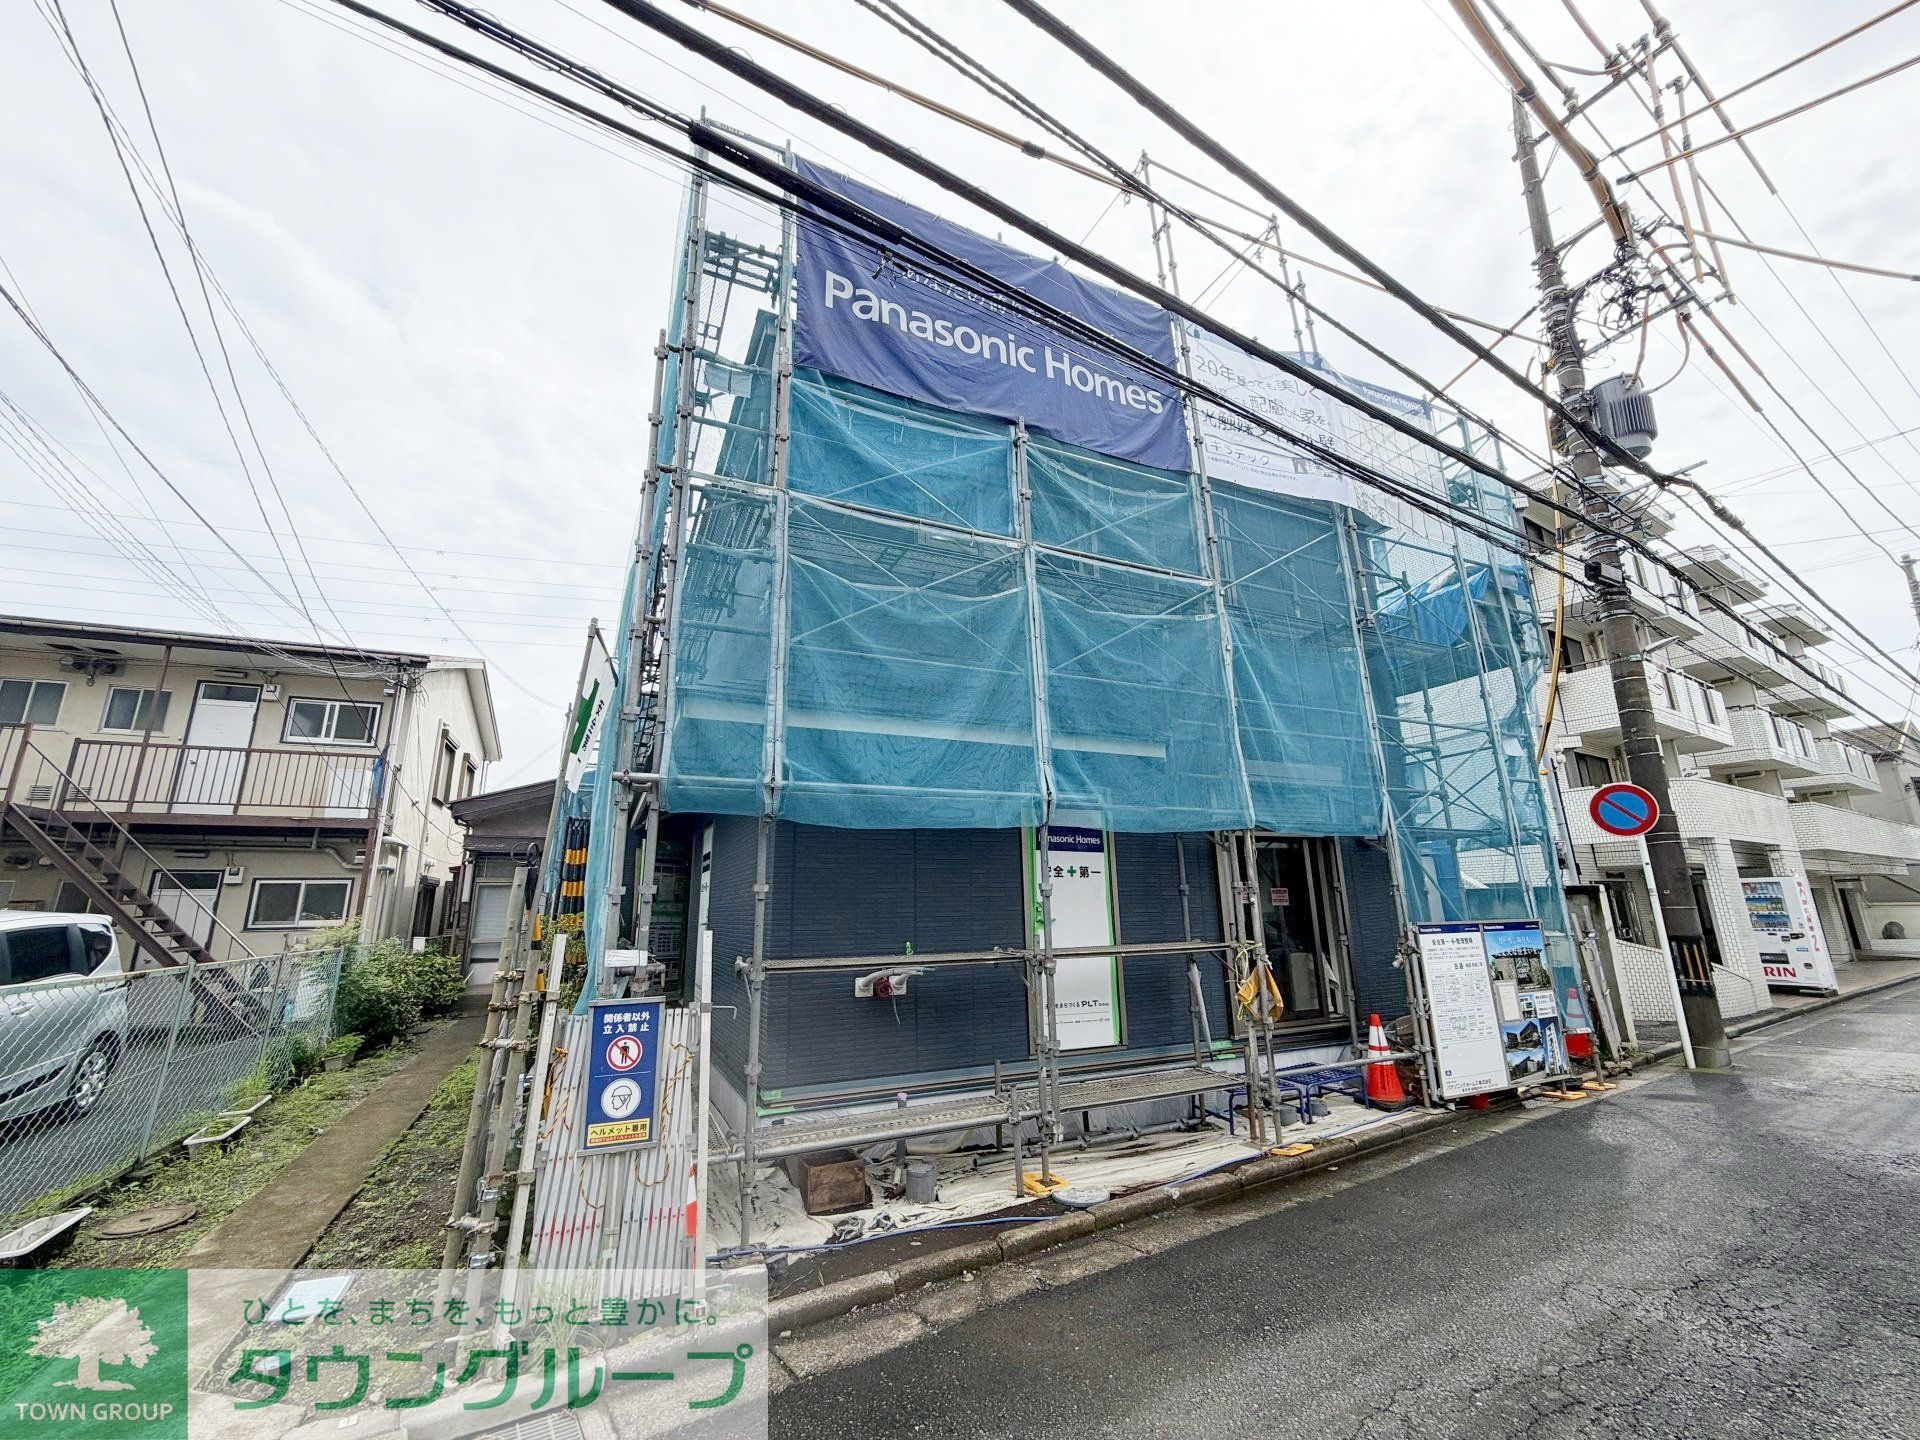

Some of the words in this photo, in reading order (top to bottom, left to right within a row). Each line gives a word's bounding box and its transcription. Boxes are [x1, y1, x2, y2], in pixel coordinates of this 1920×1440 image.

[825, 269, 1036, 373] Panasonic
[1045, 345, 1164, 414] Homes
[1362, 386, 1399, 405] Panasonic
[1038, 833, 1075, 843] nasonic
[1075, 834, 1101, 845] Homes
[1047, 865, 1064, 878] 全
[1081, 999, 1098, 1007] PLT
[603, 1010, 650, 1024] 関係者以外
[602, 1021, 650, 1035] 立入禁止
[590, 1123, 647, 1136] ヘルメット着用
